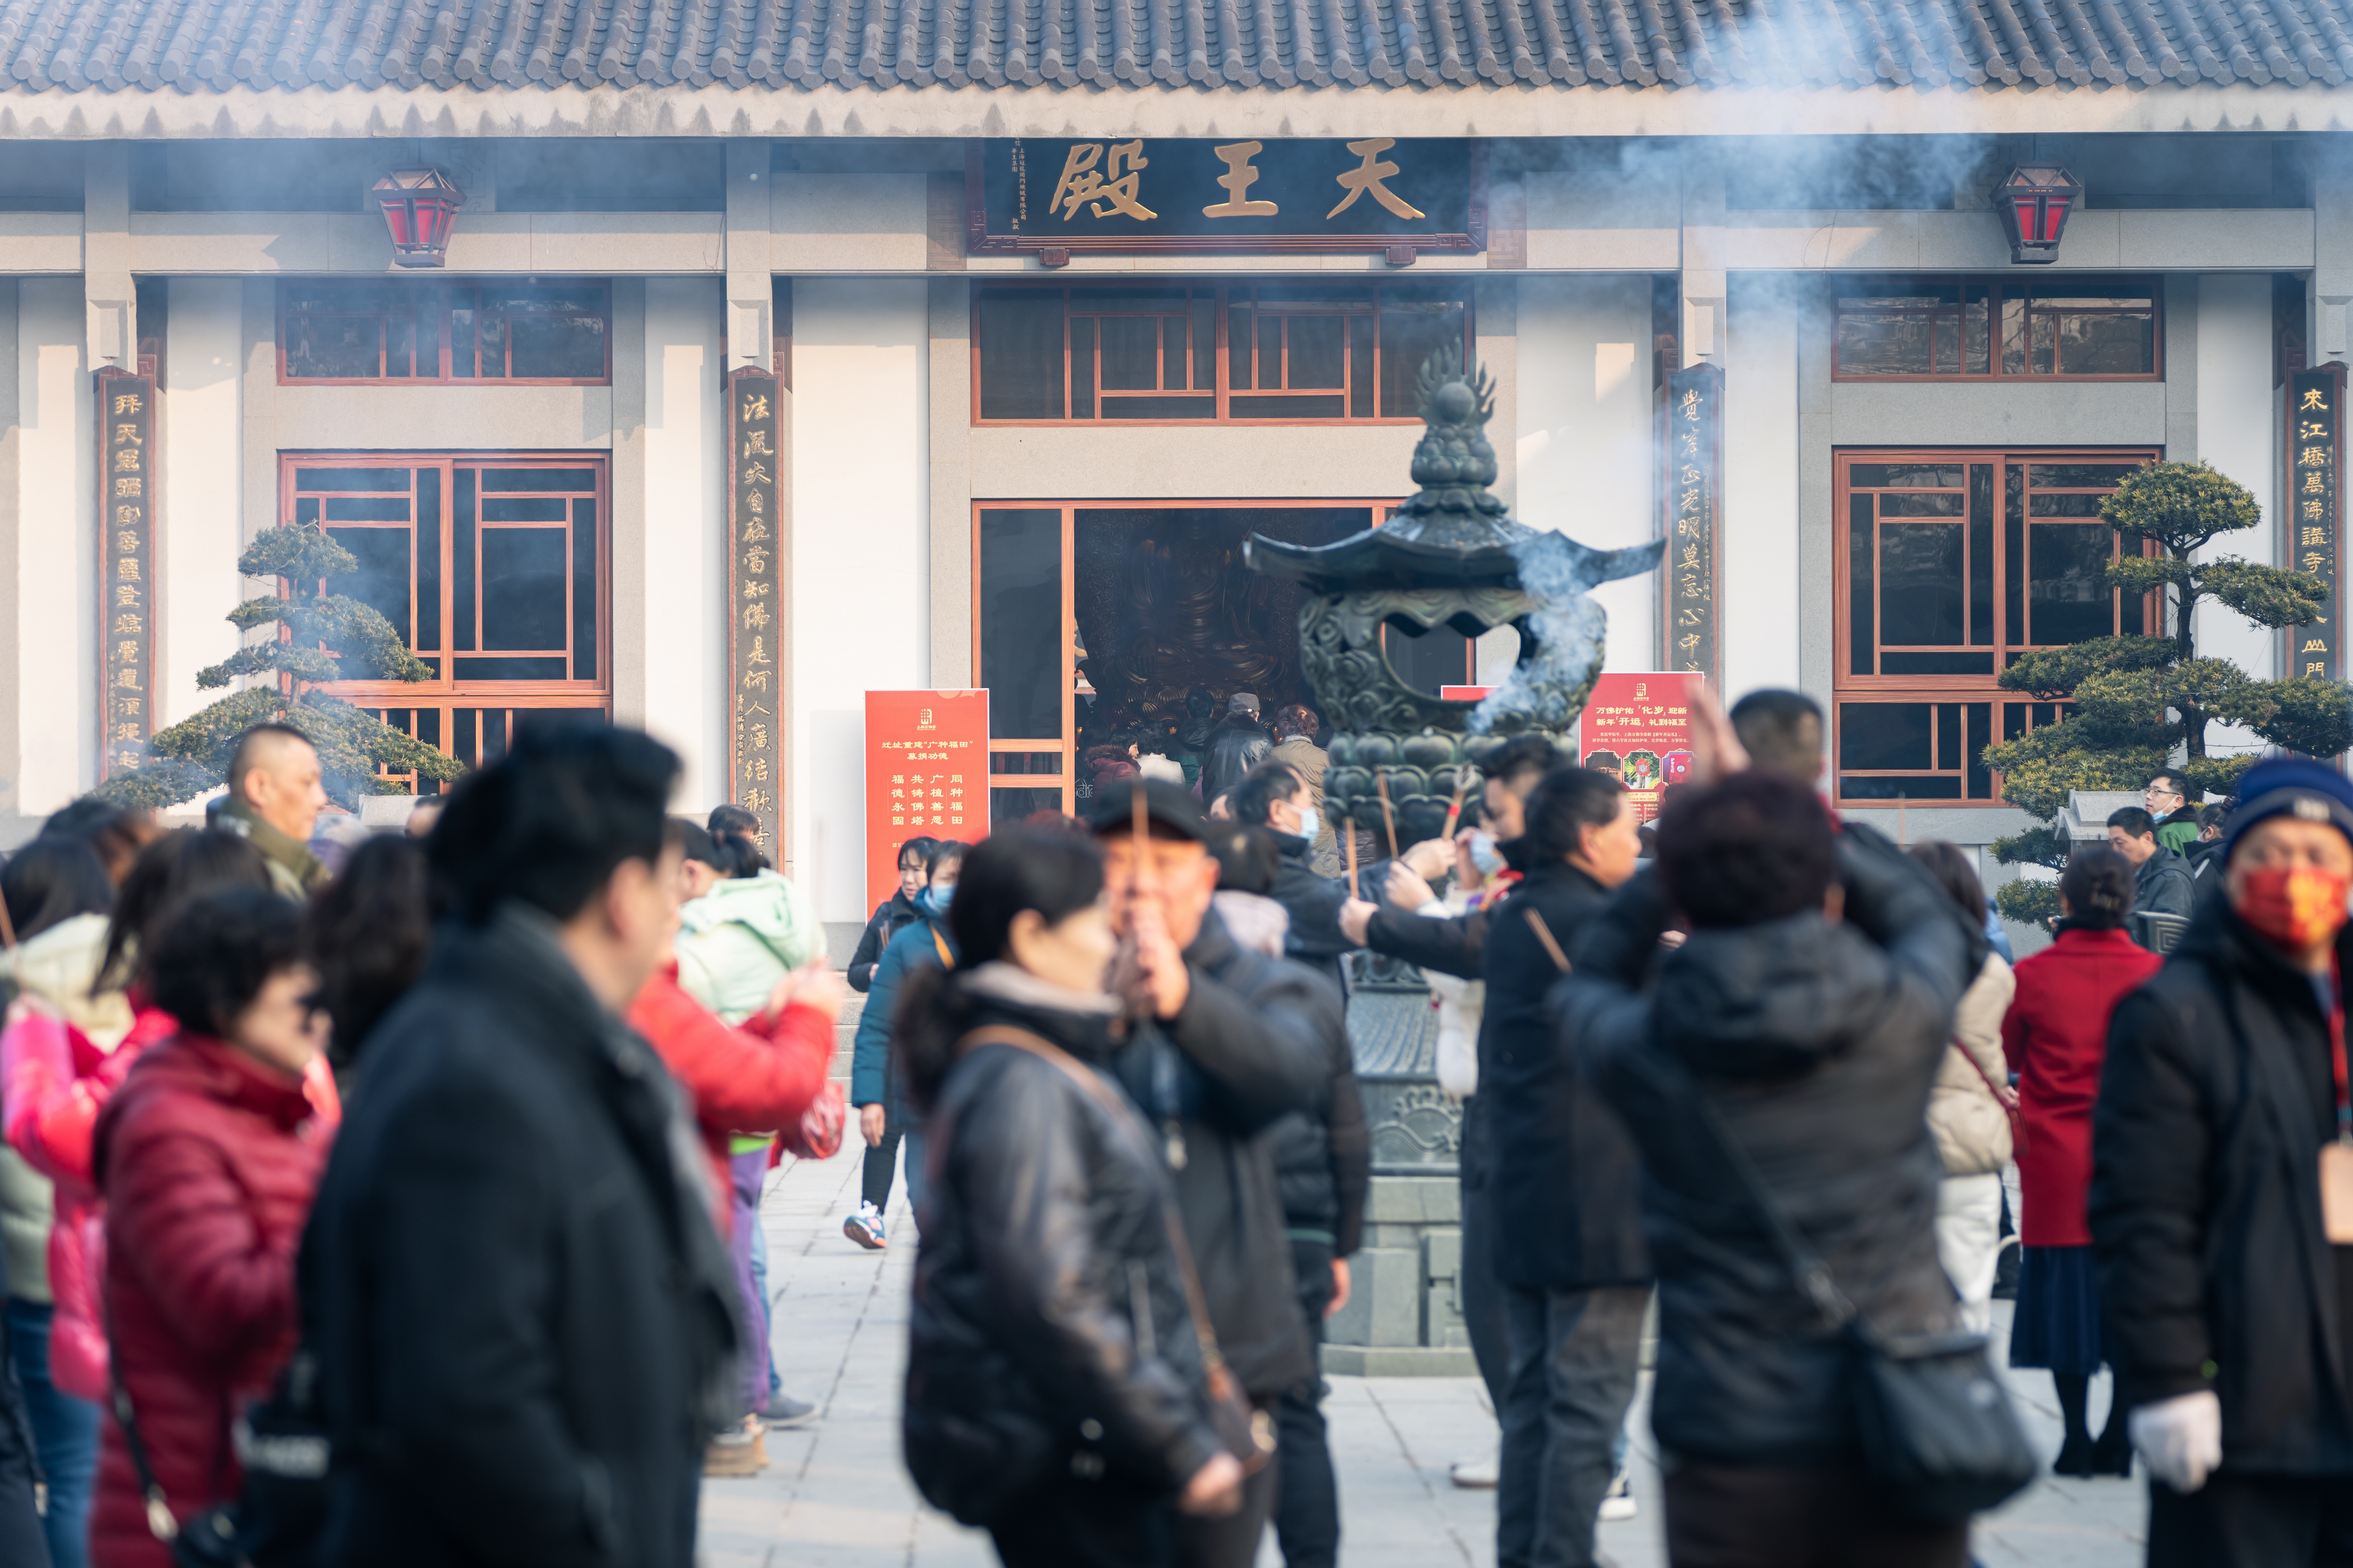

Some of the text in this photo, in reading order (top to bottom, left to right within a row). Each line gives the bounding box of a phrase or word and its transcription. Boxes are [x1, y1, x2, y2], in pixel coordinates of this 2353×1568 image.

[1049, 138, 1426, 221] 天王殿
[743, 394, 774, 856] 法流大自在當知佛是何人廣結歡喜
[2298, 388, 2328, 680] 來江橋萬佛講寺山門
